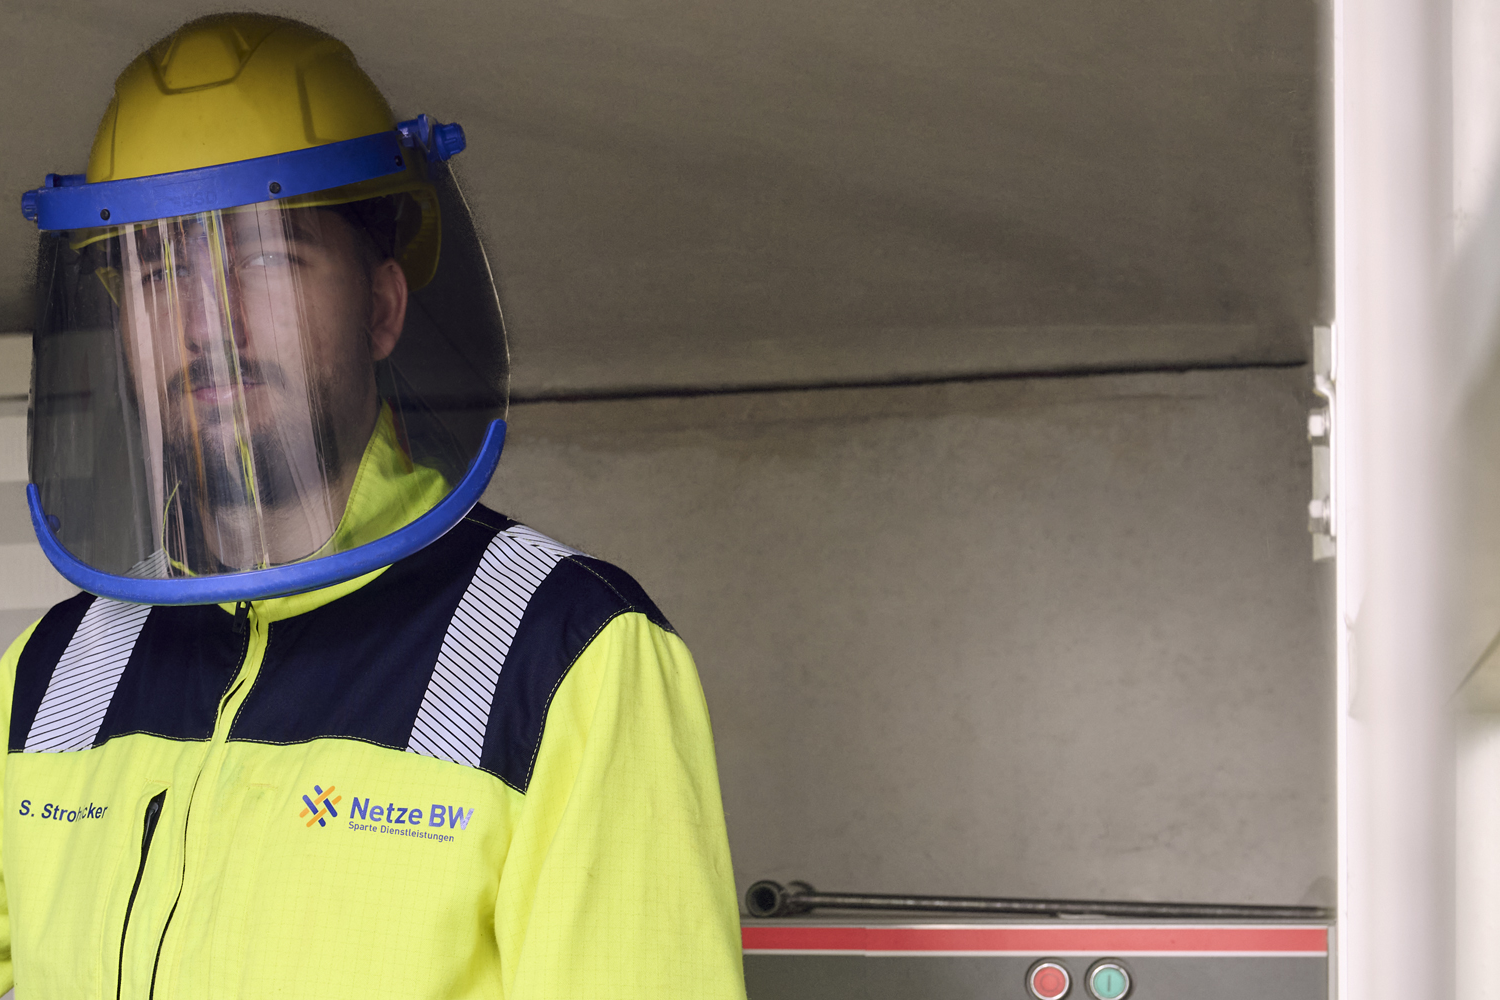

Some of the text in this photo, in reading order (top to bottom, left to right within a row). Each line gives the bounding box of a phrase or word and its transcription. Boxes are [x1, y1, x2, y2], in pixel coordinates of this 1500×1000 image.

[19, 799, 35, 817] S.
[349, 796, 475, 831] Netze BW
[348, 820, 455, 843] Sparte Dienstleistungen
